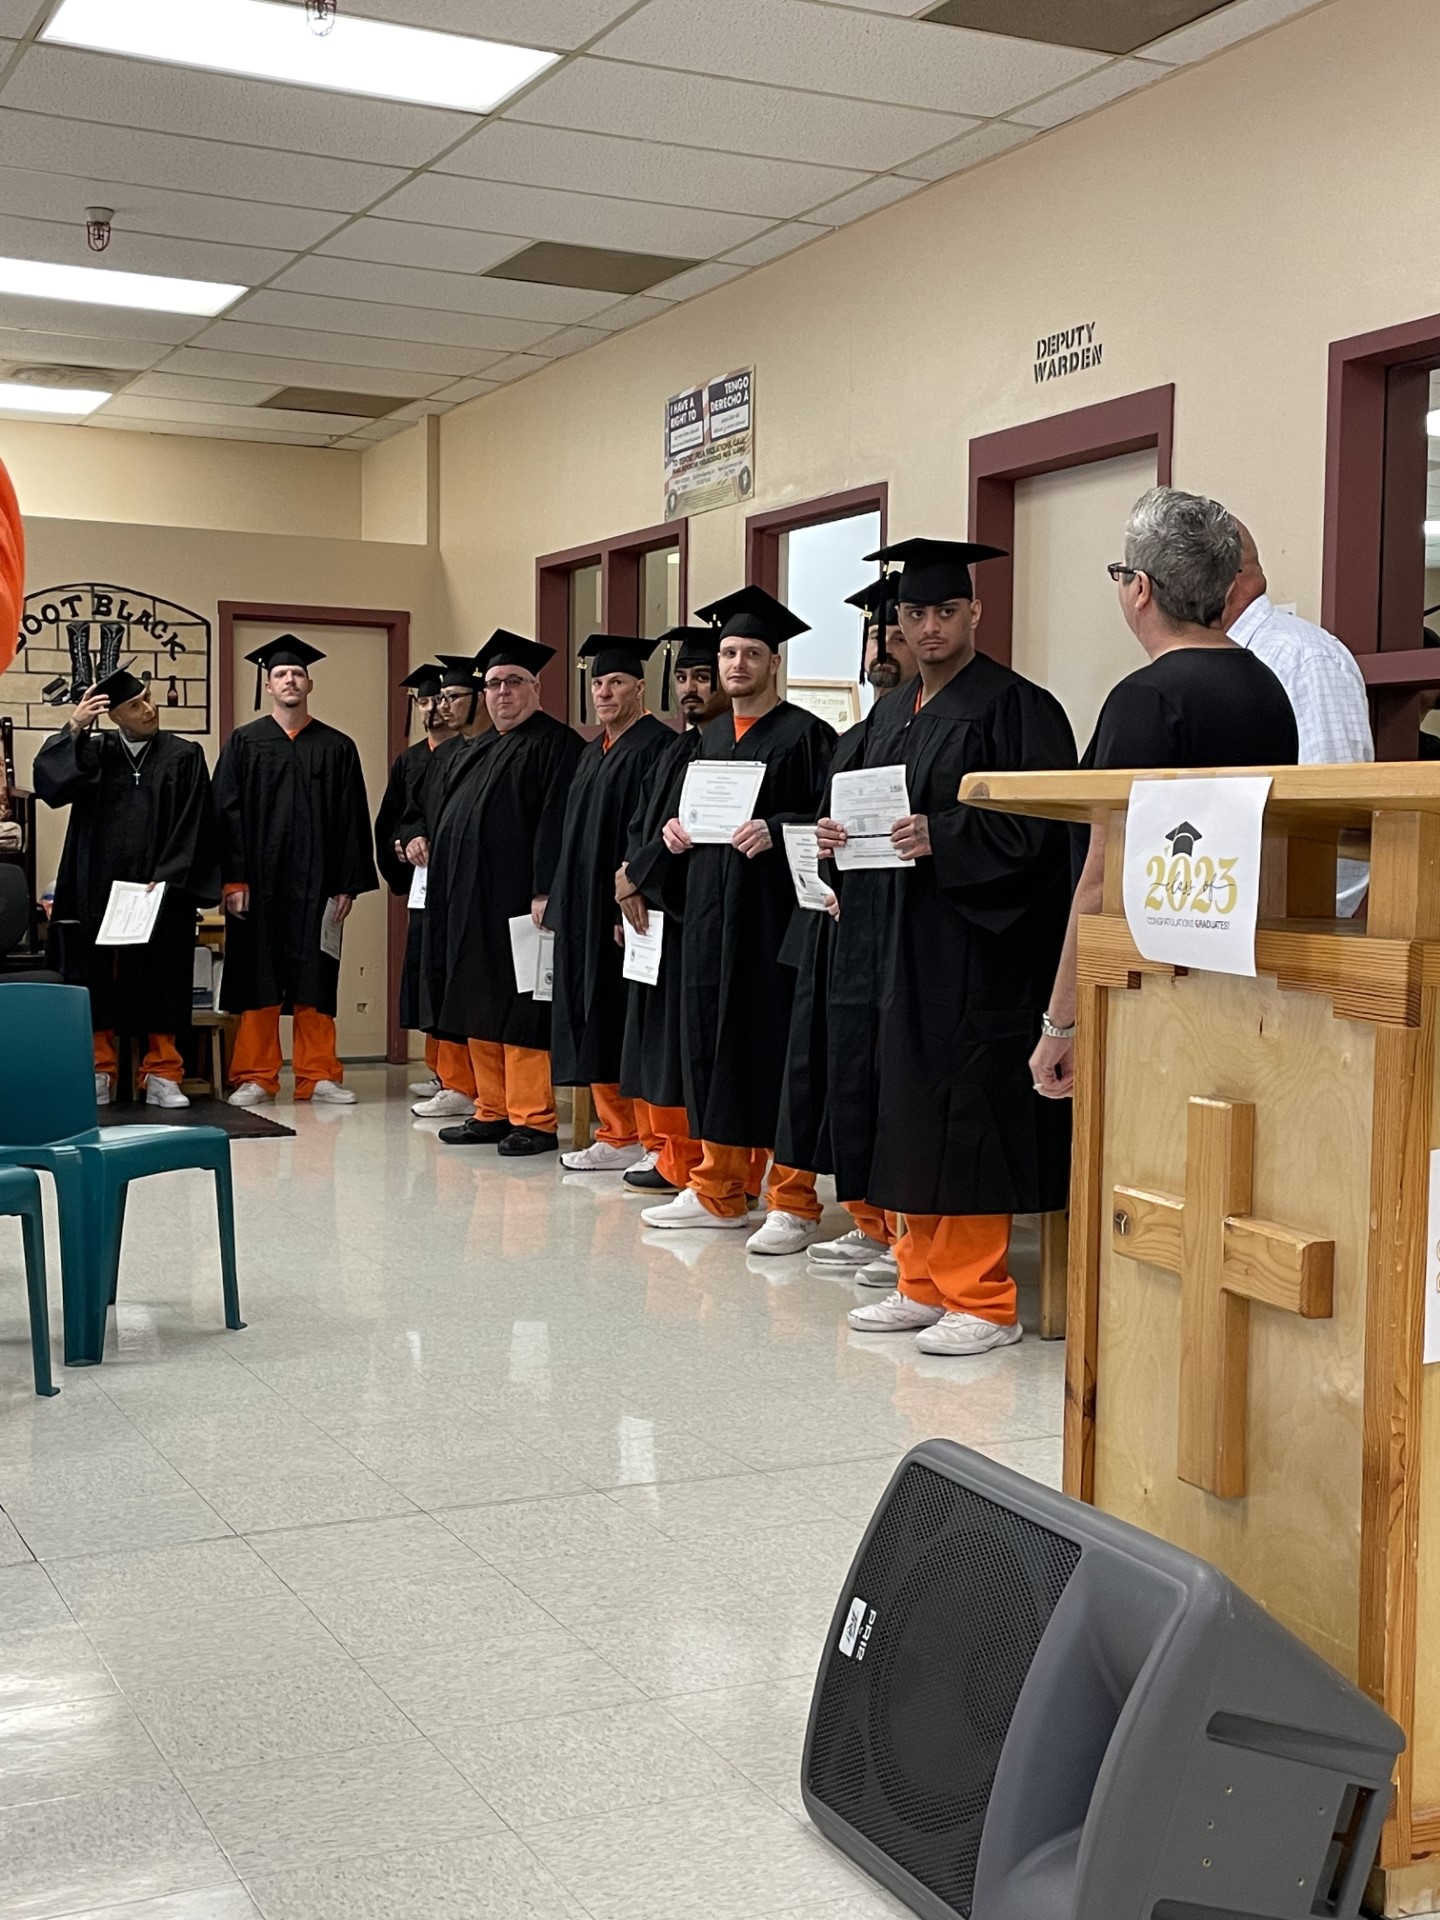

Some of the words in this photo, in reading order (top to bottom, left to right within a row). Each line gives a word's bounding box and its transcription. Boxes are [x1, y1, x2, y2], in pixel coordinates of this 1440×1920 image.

[1037, 321, 1095, 360] DEPUTY
[1034, 343, 1102, 384] WARDEN
[724, 376, 749, 394] TENGO
[674, 399, 689, 414] HAVE
[689, 397, 695, 408] A
[710, 392, 742, 412] DERECHO
[743, 389, 749, 402] A
[671, 412, 687, 429] RIGHT
[688, 409, 697, 421] TO
[1145, 855, 1239, 914] 2023
[1157, 871, 1195, 896] class
[1147, 917, 1194, 928] CONGRATULATIONS
